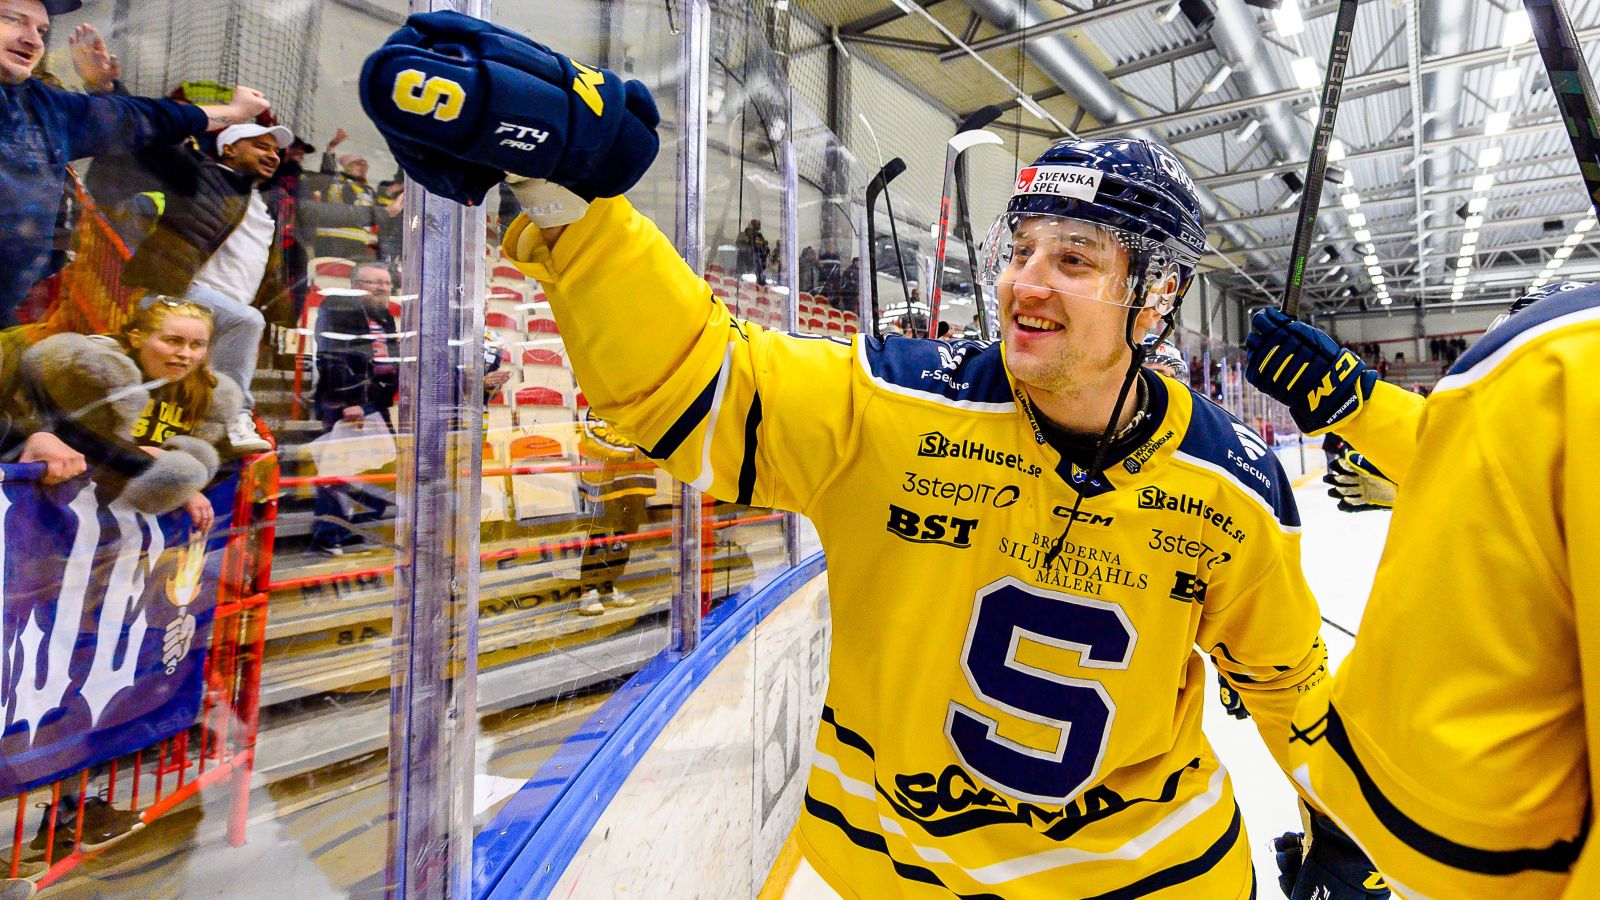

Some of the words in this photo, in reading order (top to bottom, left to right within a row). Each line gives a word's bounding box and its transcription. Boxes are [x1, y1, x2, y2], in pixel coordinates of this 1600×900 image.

[392, 69, 466, 122] S
[1317, 31, 1352, 150] RIBCOR
[500, 139, 536, 151] PRO
[1032, 182, 1061, 193] SPEL
[1036, 172, 1095, 187] SVENSKA
[1179, 231, 1206, 249] CCM
[918, 431, 1042, 478] SkalHuset.se
[1140, 431, 1174, 465] ALLSVENSKAN
[1227, 449, 1271, 489] F-Secure
[887, 503, 979, 547] BST
[1053, 505, 1114, 527] CCM
[1135, 486, 1246, 544] SkalHset.se
[1036, 569, 1102, 595] MÅLERI
[943, 575, 1138, 806] S
